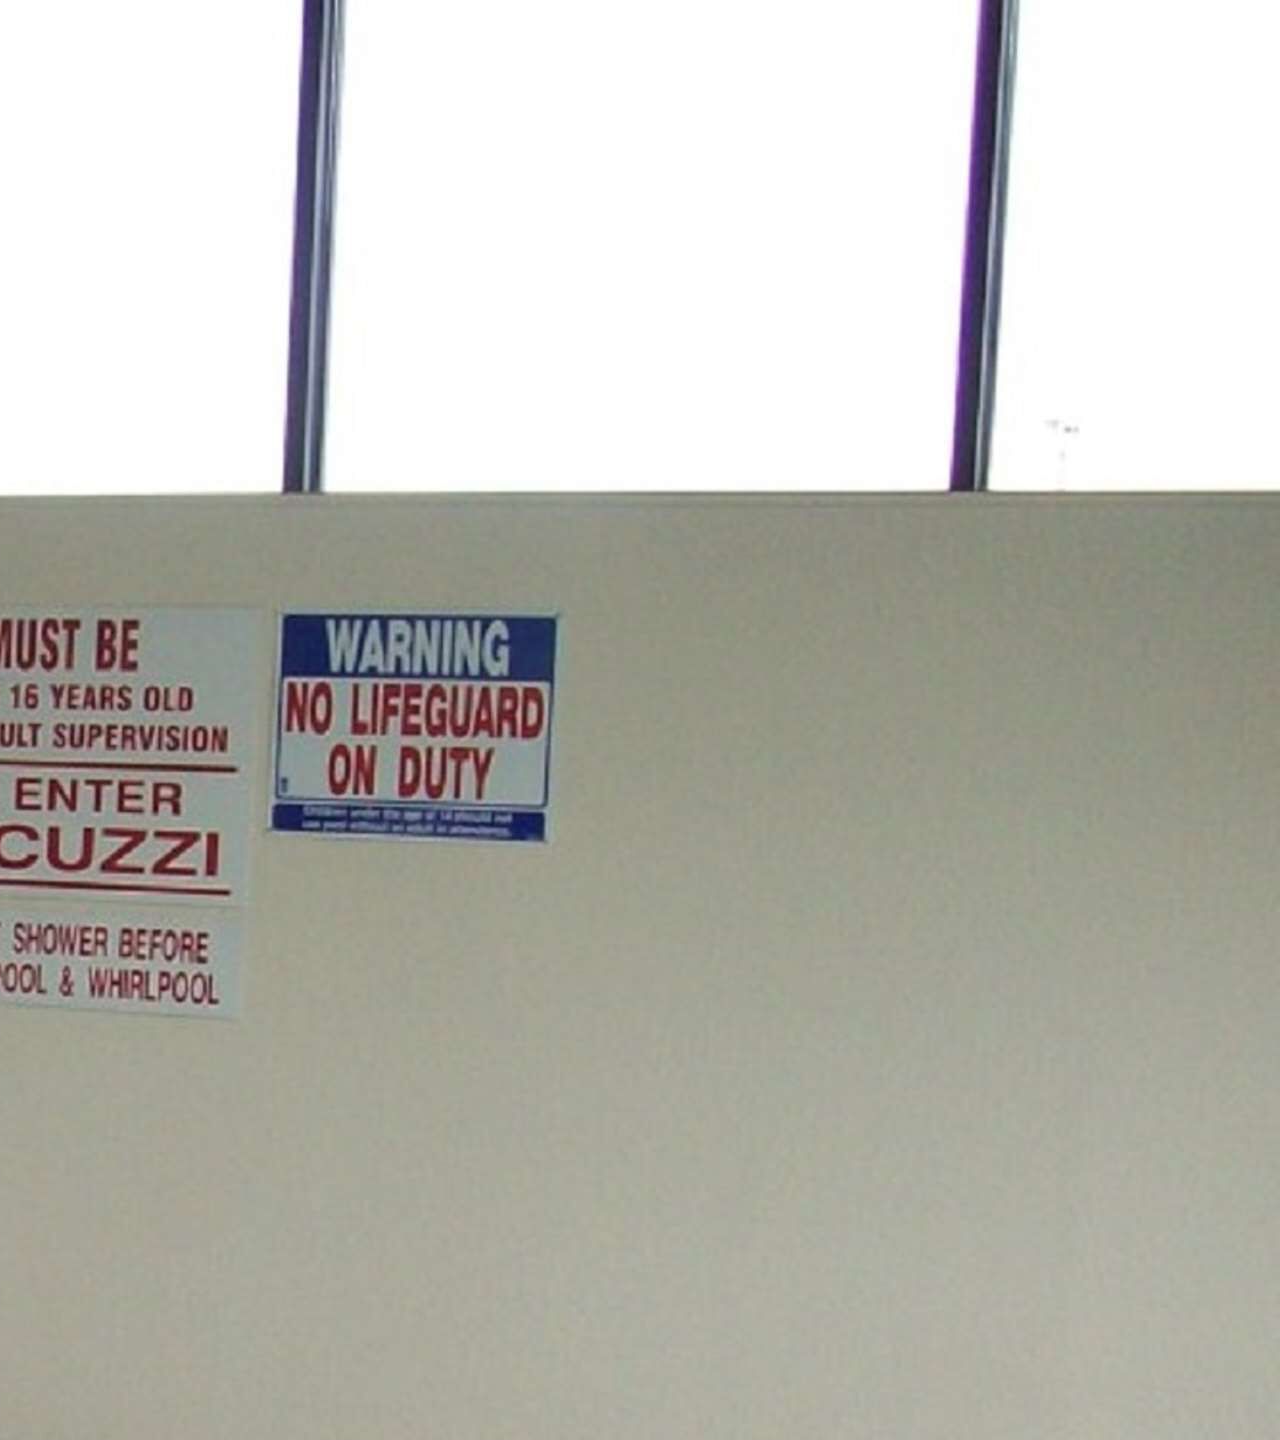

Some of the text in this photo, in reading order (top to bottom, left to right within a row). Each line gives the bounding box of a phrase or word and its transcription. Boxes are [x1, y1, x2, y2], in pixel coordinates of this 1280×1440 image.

[94, 618, 140, 673] BE
[325, 618, 510, 677] WARNING
[10, 684, 40, 711] 16
[50, 684, 133, 712] YEARS
[142, 685, 195, 713] OLD
[285, 680, 545, 739] NO LIFEGUARD
[52, 722, 229, 753] SUPERVISION
[327, 742, 496, 800] ON DUTY
[14, 778, 184, 816] ENTER
[13, 922, 109, 958] SHOWER
[118, 928, 210, 965] BEFORE
[58, 965, 75, 998] &
[88, 966, 221, 1006] WHIRLPOOL
